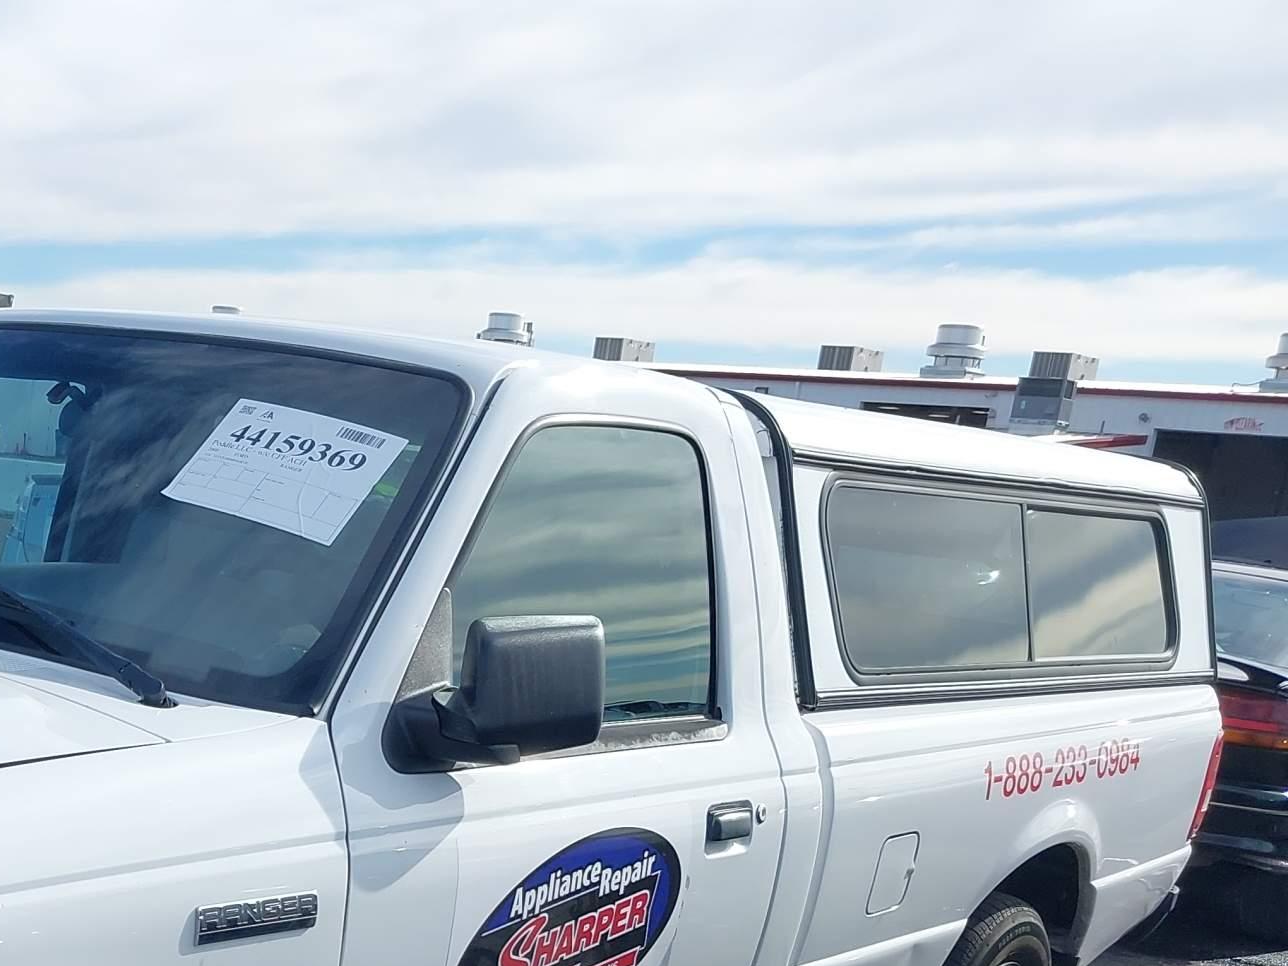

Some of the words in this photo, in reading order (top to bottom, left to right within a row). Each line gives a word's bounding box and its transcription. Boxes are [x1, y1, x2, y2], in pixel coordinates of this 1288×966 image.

[229, 424, 368, 471] 44159369
[984, 737, 1141, 801] 1-888-233-0984
[198, 893, 318, 931] RANGER
[509, 860, 602, 921] Appliance
[598, 849, 657, 898] Repair
